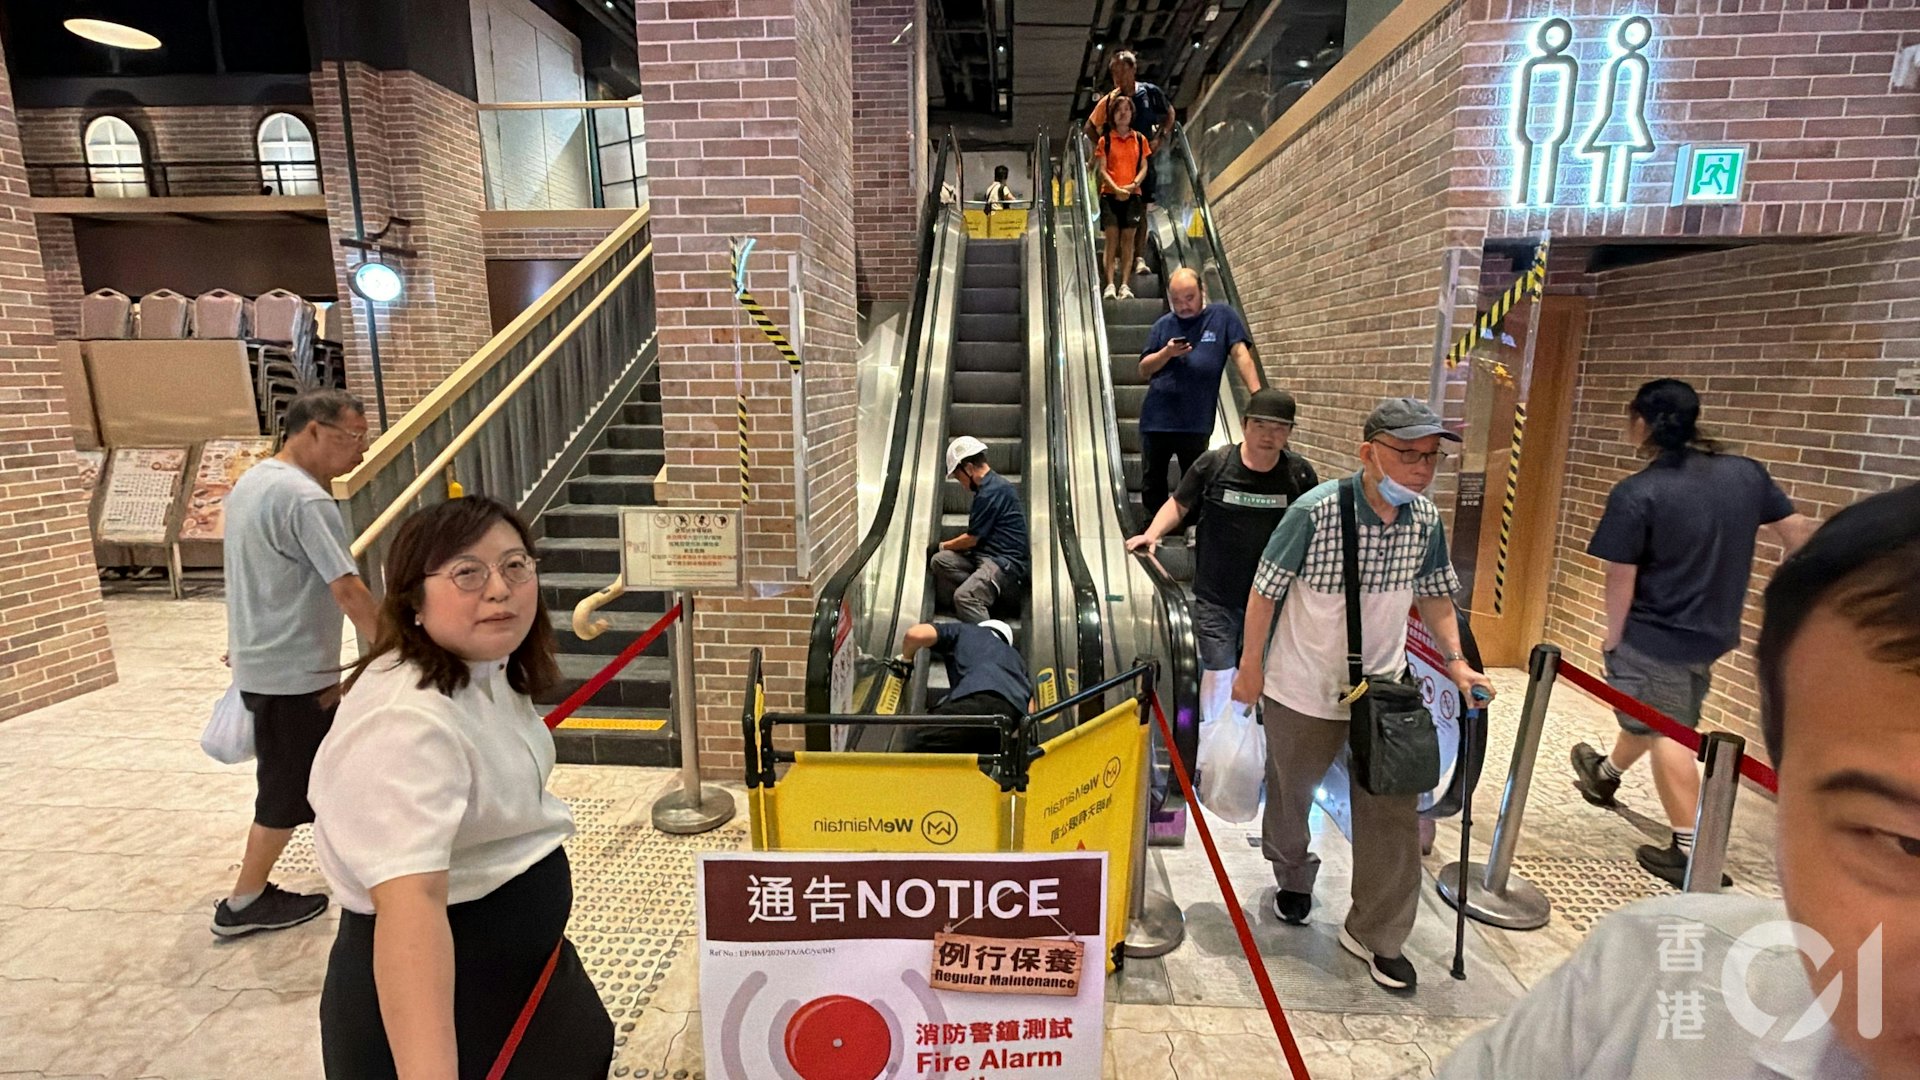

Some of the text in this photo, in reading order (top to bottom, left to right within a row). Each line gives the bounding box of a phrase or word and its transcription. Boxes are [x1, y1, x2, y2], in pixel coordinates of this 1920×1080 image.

[746, 874, 1061, 923] 通告 NOTICE
[938, 942, 1077, 974] 例行保養
[935, 970, 1075, 989] Regular Maintenance
[916, 1017, 1073, 1045] 消防警鐘測試
[917, 1049, 1062, 1073] Fire Alarm
